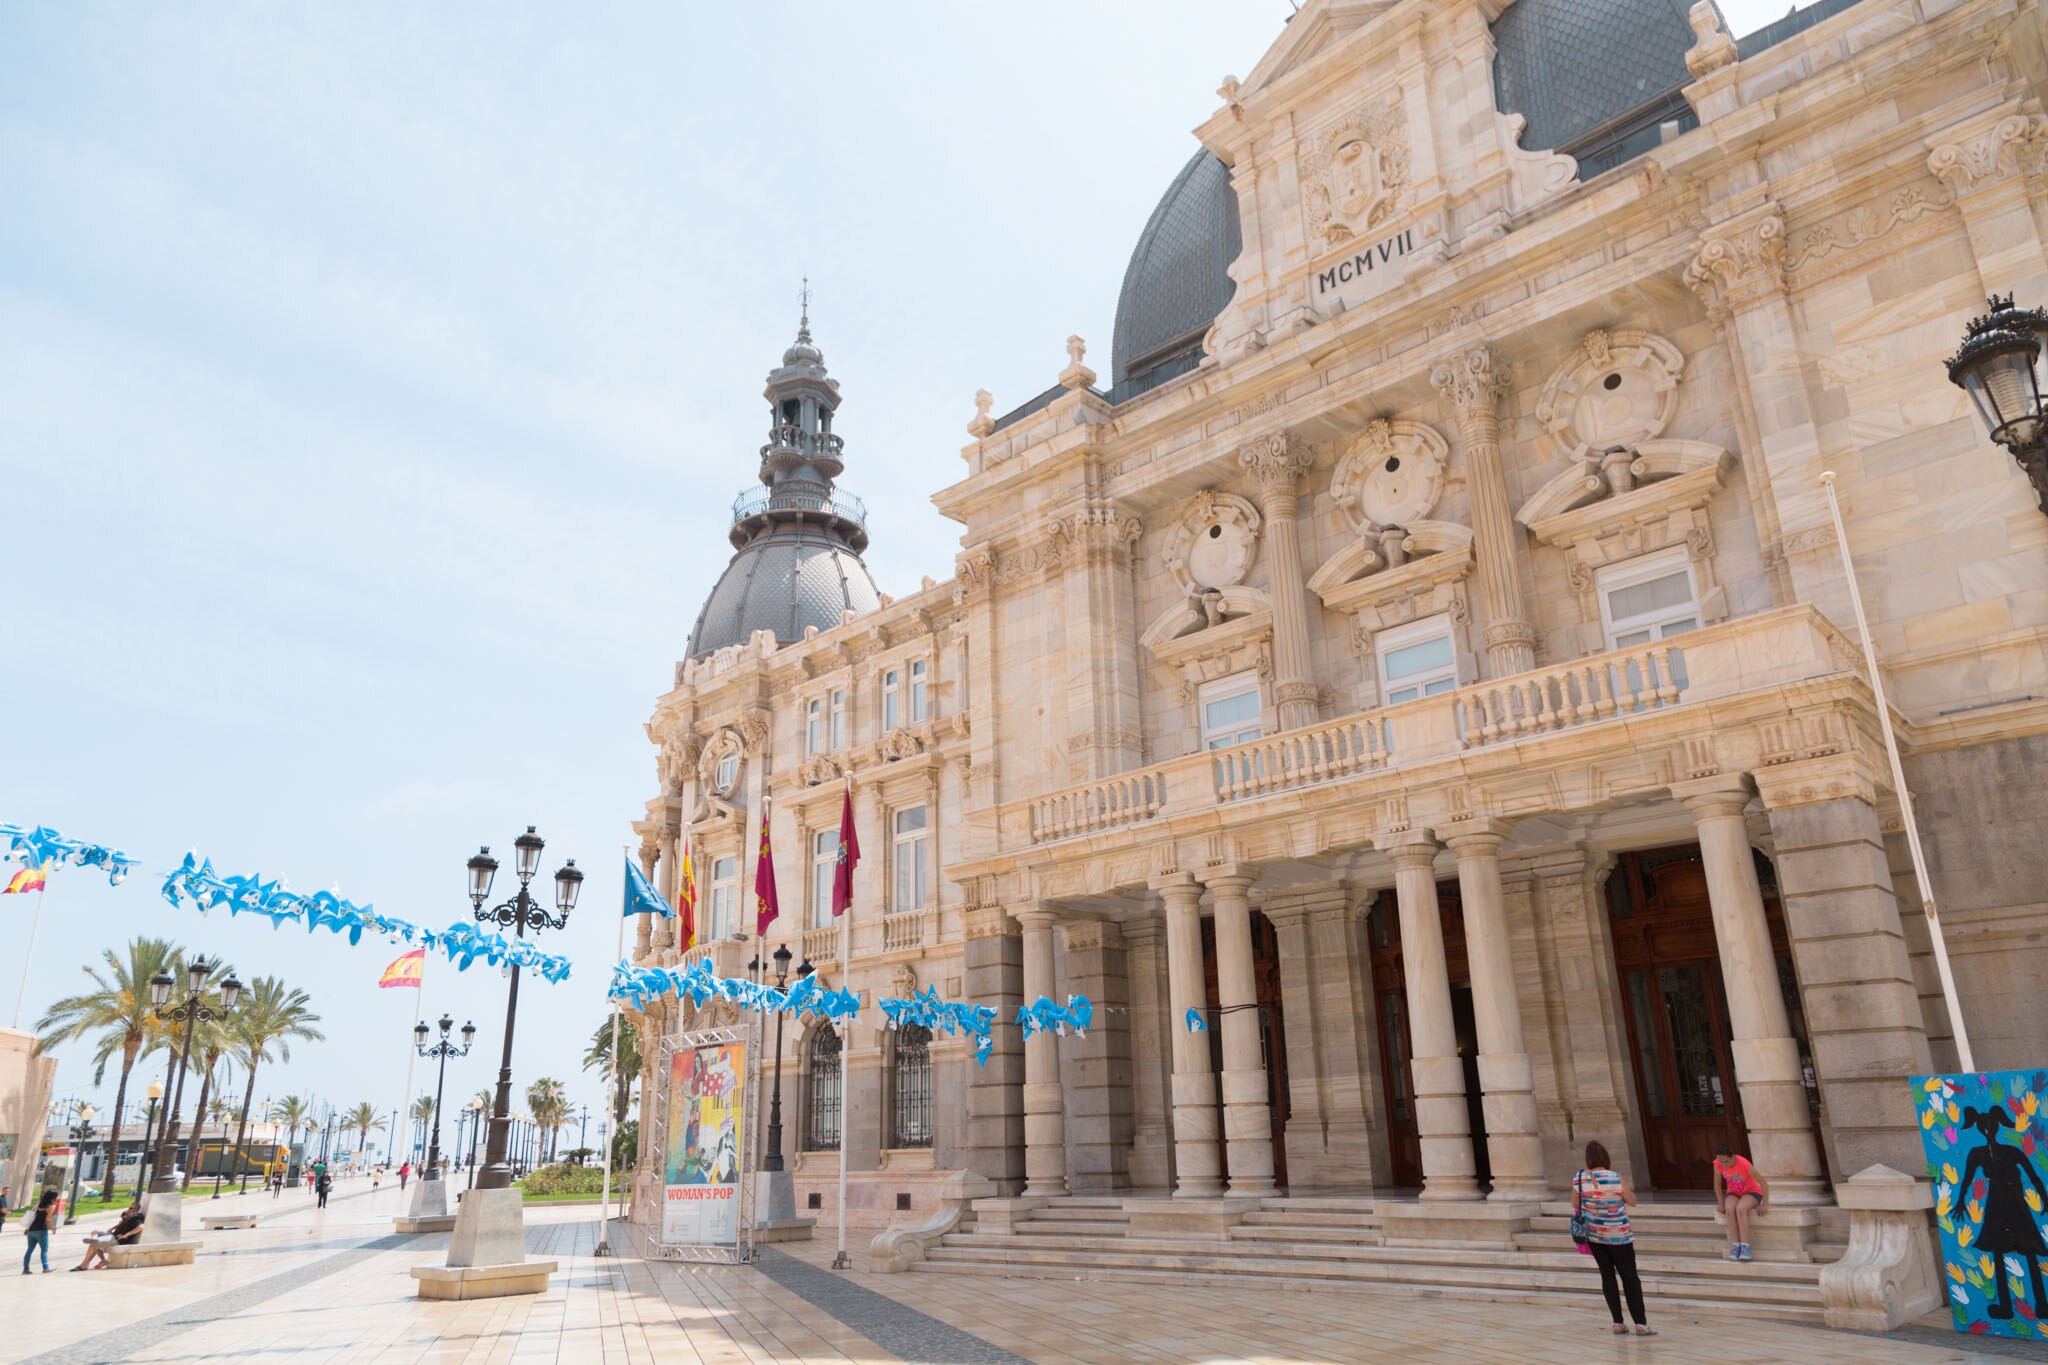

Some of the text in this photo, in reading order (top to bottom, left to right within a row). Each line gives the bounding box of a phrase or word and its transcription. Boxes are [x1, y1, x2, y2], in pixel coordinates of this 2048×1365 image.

[1318, 229, 1413, 294] MCMVII
[667, 1187, 734, 1200] WOMAN'S POP
